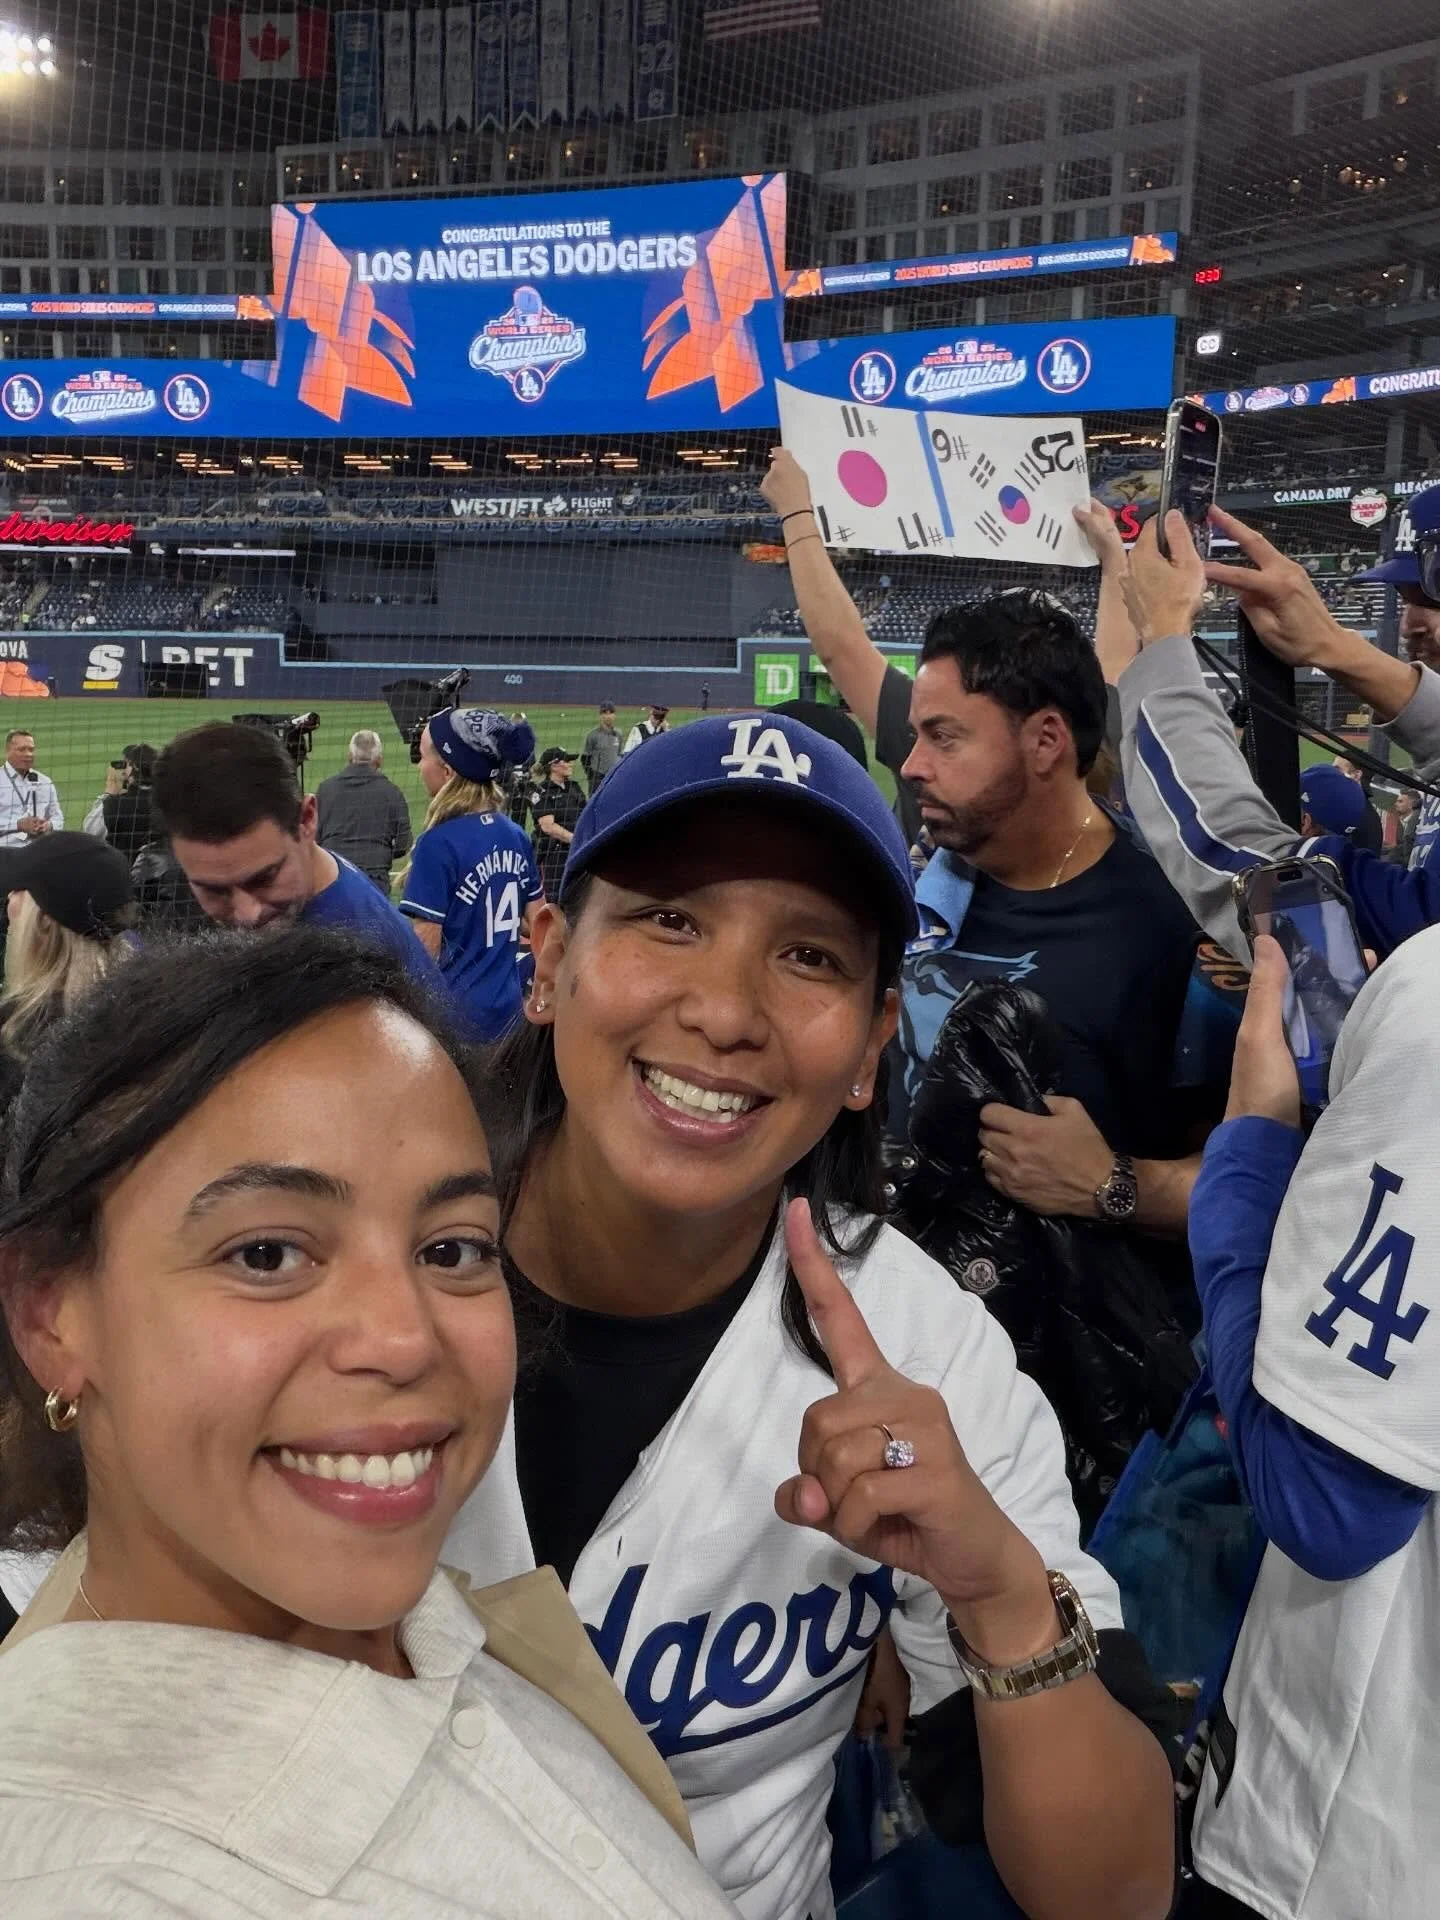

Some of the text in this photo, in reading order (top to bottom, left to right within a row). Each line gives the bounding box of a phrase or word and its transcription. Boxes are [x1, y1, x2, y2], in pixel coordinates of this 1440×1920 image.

[441, 220, 611, 245] CONGRATULATIONS TO THE
[357, 235, 697, 282] LOS ANGELES DODGERS
[471, 330, 583, 365] Champions
[923, 351, 1012, 365] WORLD SERIES
[861, 359, 886, 395] LA
[905, 358, 1026, 397] Champions
[1050, 346, 1078, 385] LA
[11, 380, 35, 413] LA
[175, 380, 200, 413] LA
[521, 371, 539, 397] LA
[52, 389, 156, 418] Champions
[1031, 430, 1088, 474] #25
[450, 497, 613, 519] WESTJET FLIGHT
[1273, 487, 1351, 503] CANADA DRY
[1352, 502, 1386, 511] CANADA
[1395, 509, 1418, 552] LA
[0, 640, 28, 659] OVA
[504, 674, 523, 685] 400
[759, 663, 794, 695] TD
[720, 718, 812, 788] LA
[485, 881, 521, 948] 14
[1304, 1160, 1430, 1381] LA
